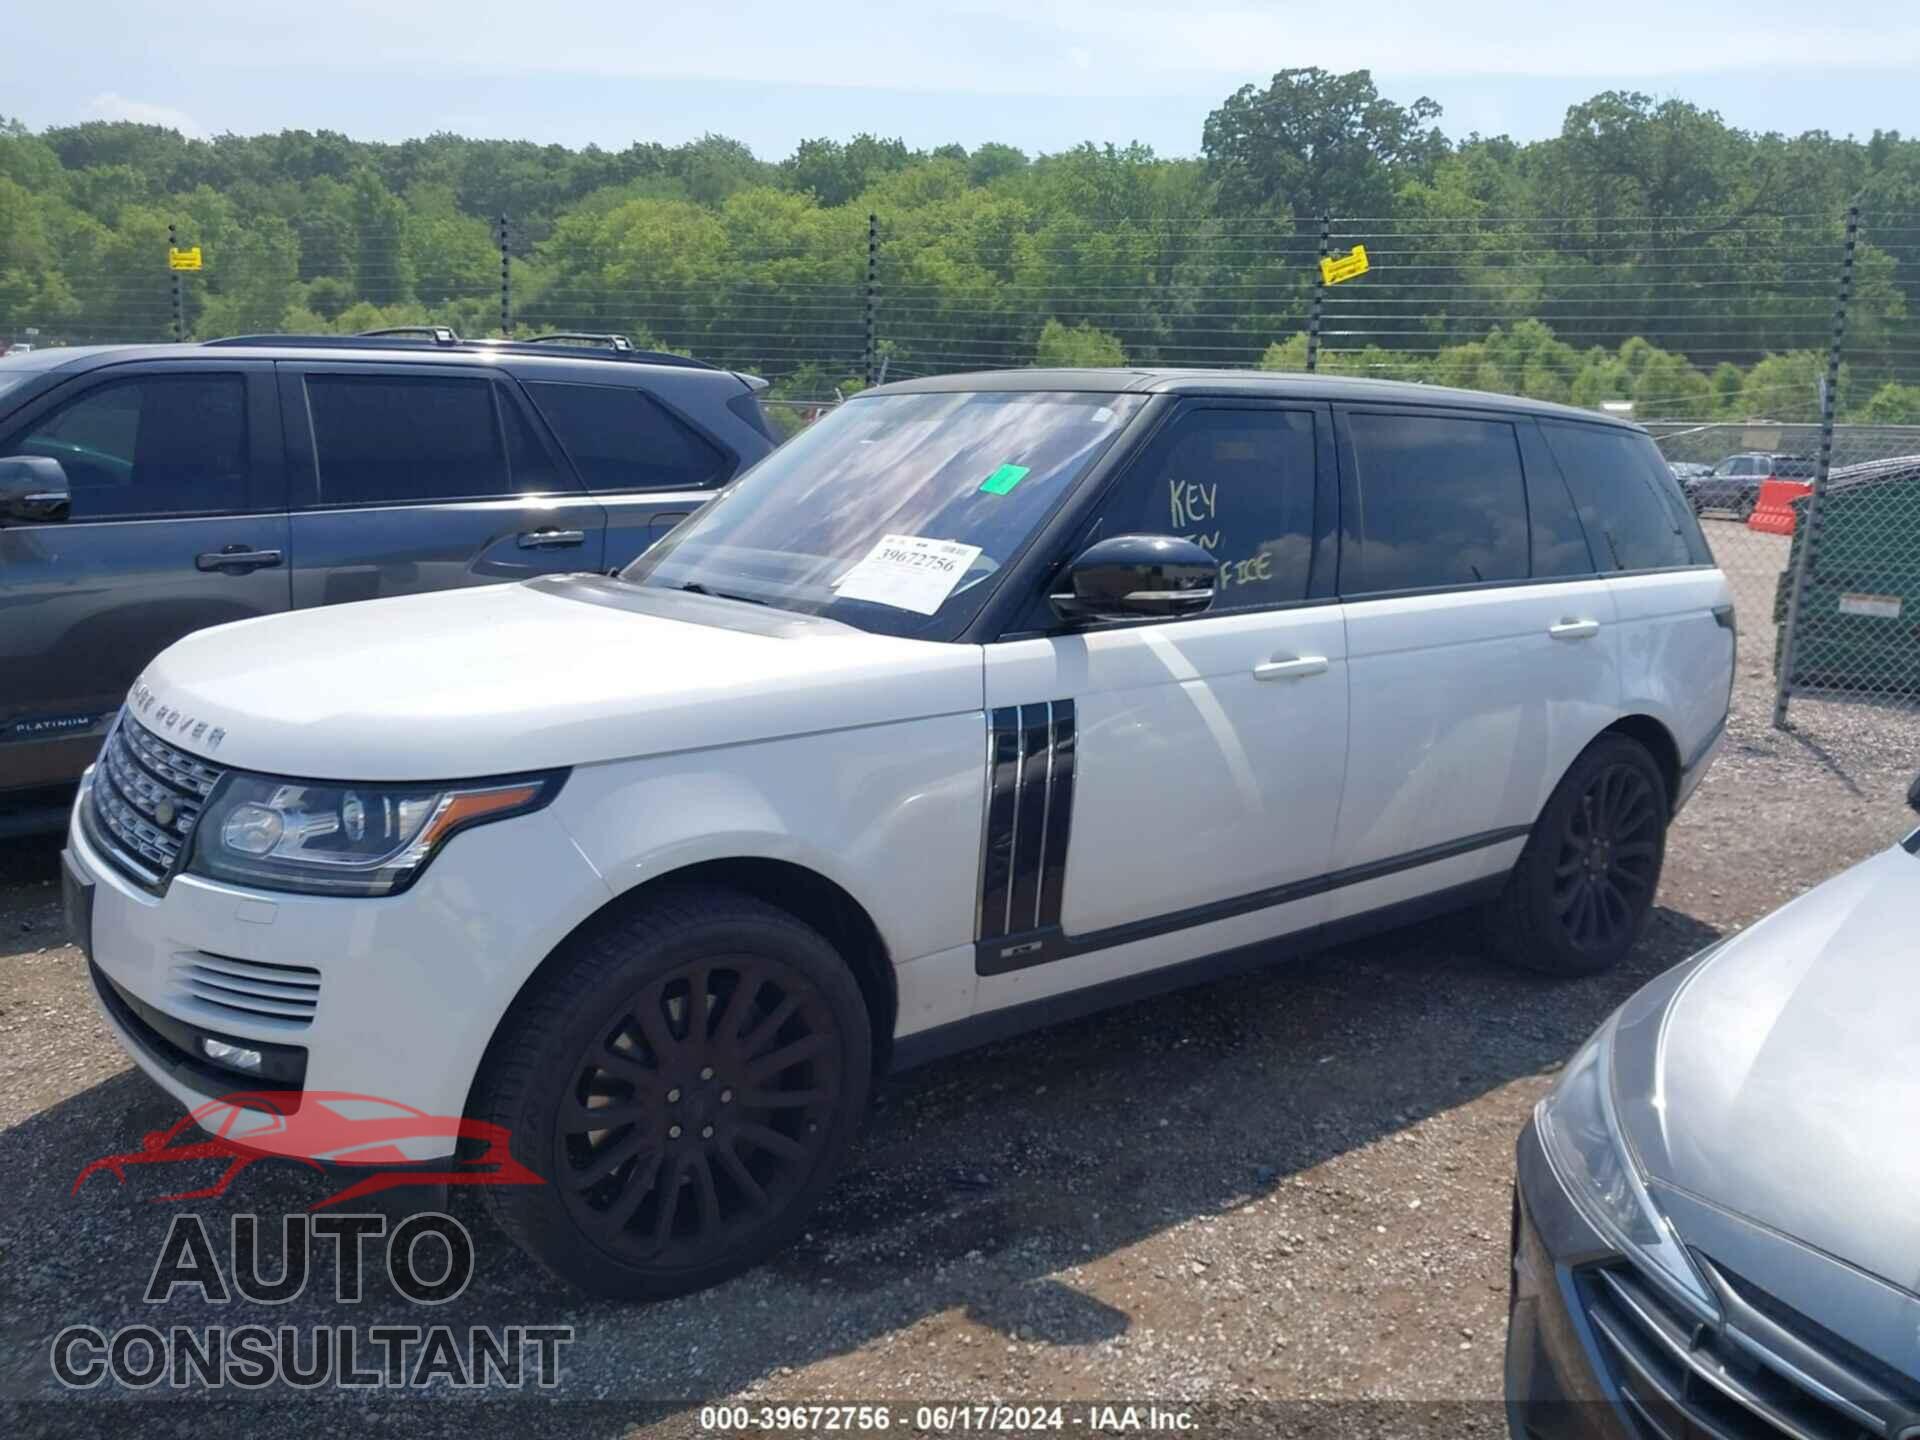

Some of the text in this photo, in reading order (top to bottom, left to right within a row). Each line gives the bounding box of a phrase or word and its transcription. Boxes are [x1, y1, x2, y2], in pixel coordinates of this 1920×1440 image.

[1169, 479, 1217, 528] KEY
[1183, 531, 1220, 550] N
[882, 548, 955, 572] 39672756
[1220, 552, 1273, 590] FICE
[16, 717, 89, 732] PLATINUM
